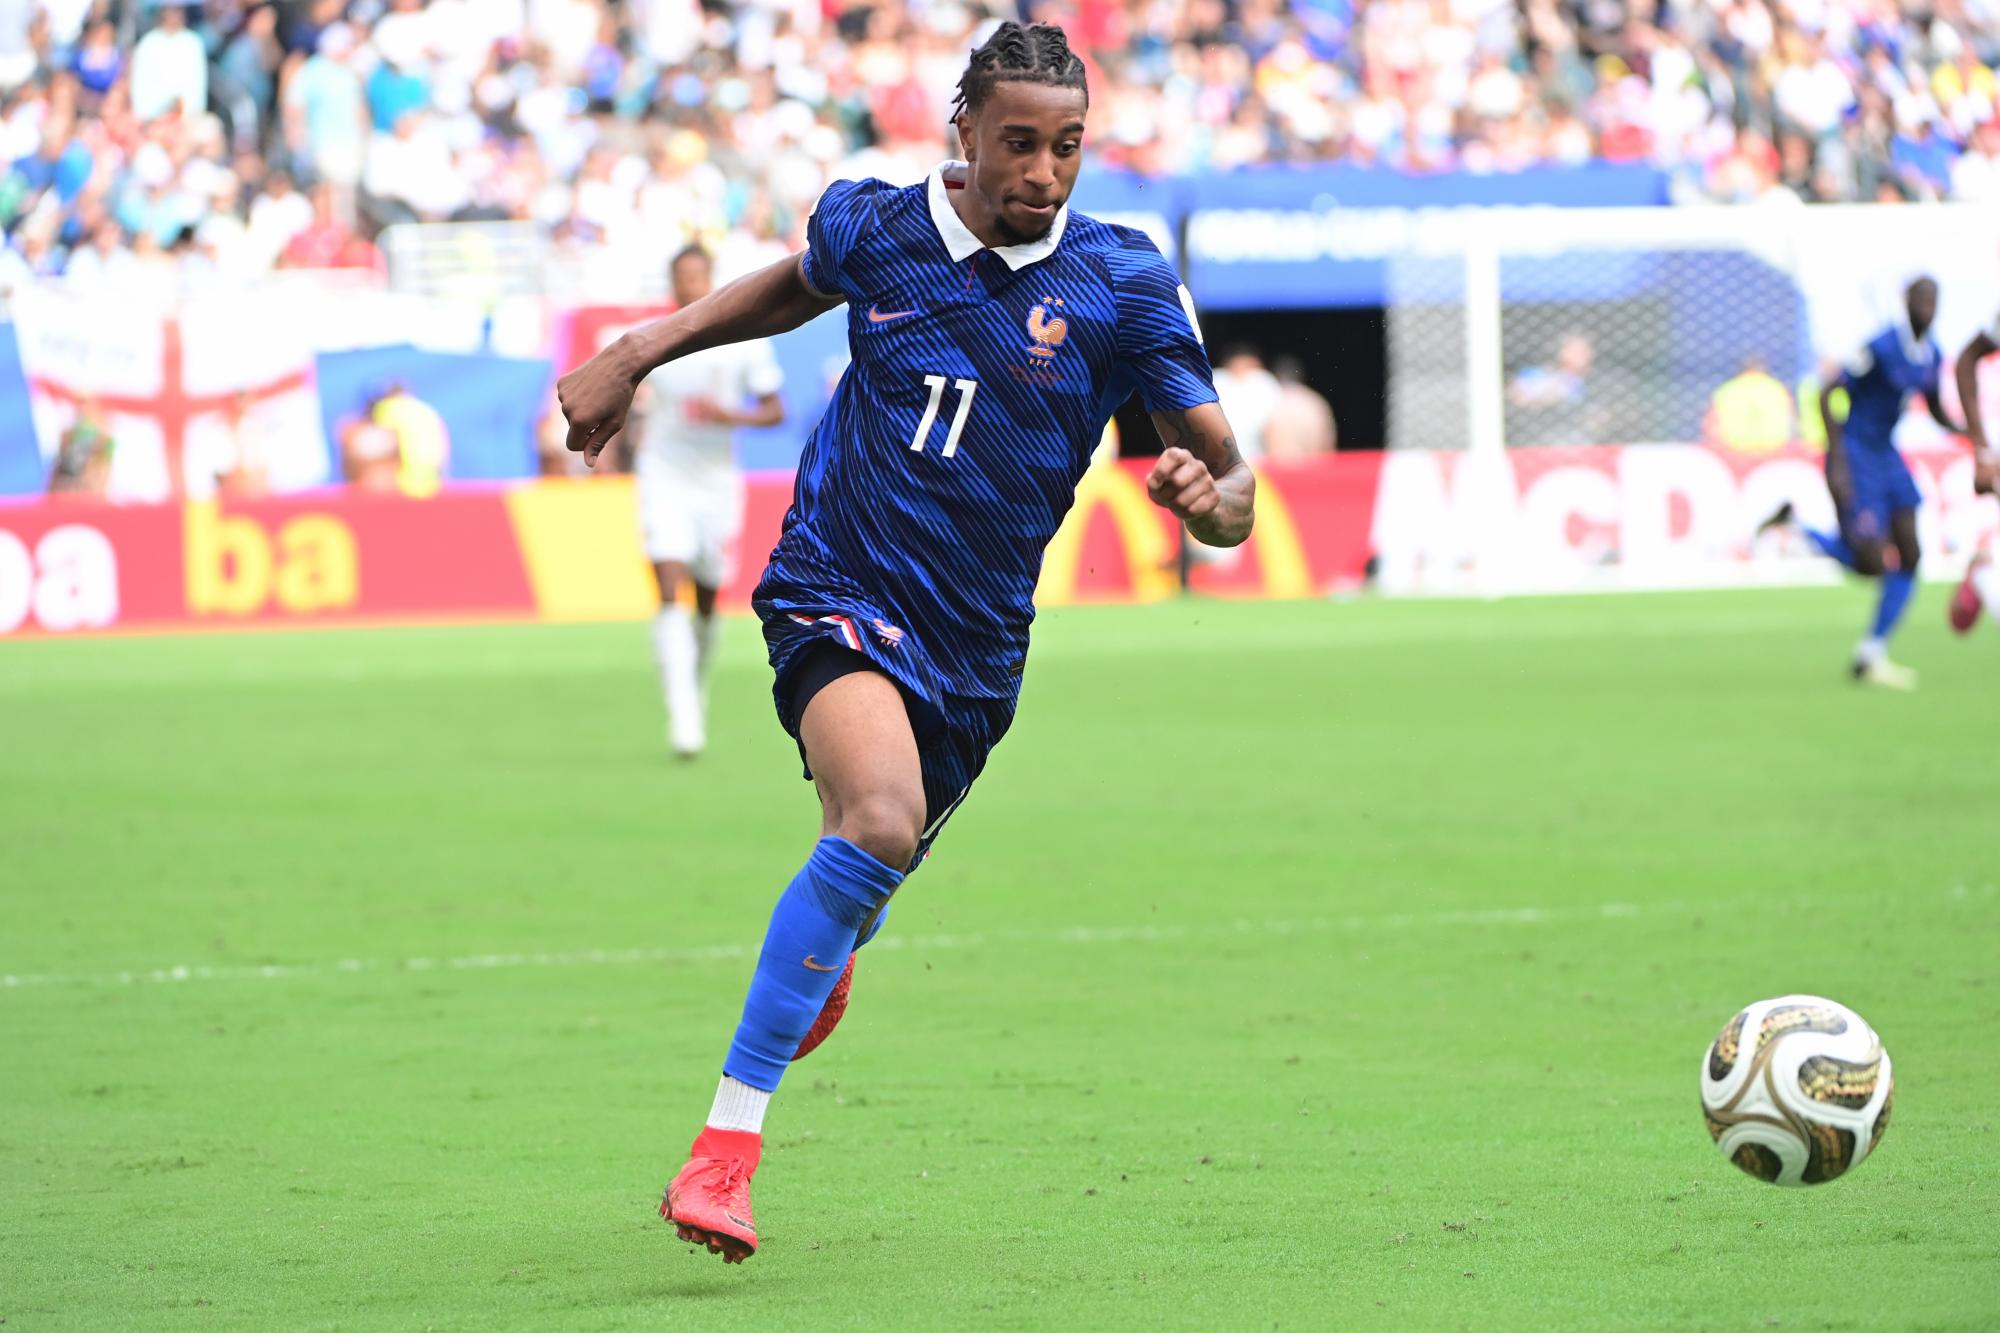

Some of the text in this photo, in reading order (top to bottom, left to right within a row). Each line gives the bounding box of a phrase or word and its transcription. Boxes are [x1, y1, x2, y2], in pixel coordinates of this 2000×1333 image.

[1029, 357, 1051, 368] FFF
[910, 374, 979, 459] 11
[183, 494, 358, 616] ba
